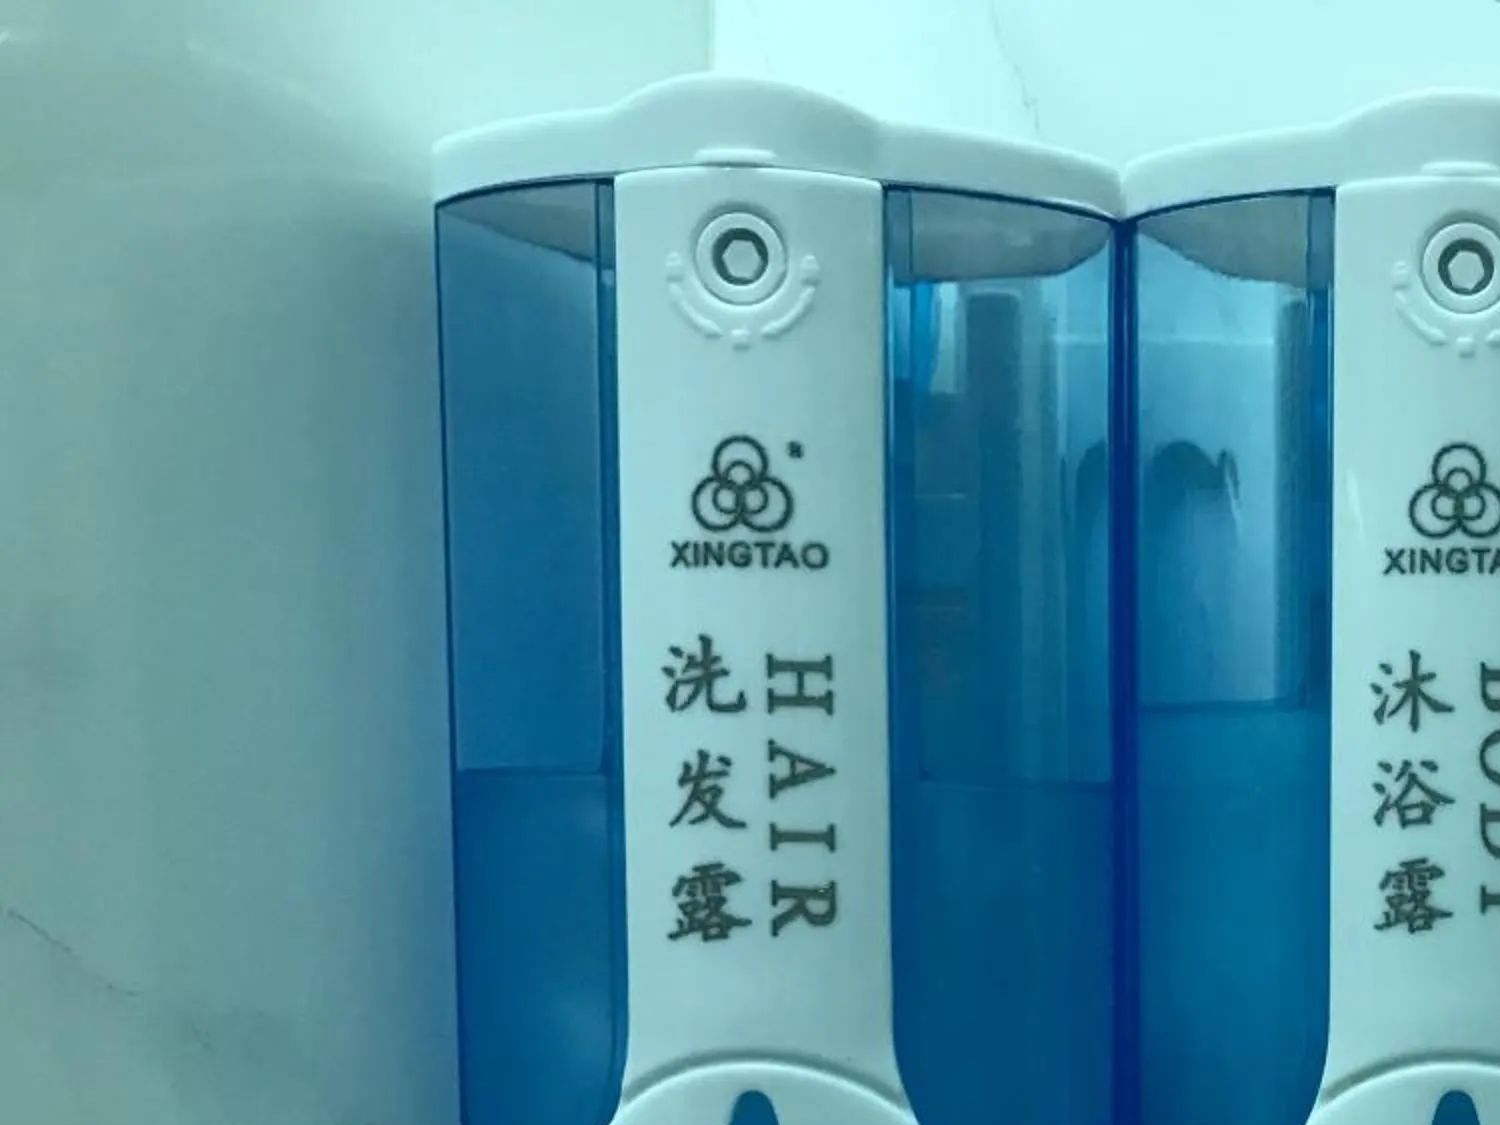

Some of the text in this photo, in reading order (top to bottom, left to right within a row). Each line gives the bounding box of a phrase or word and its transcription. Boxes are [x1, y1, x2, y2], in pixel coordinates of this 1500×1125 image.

[669, 541, 830, 570] XINGTAO
[661, 633, 753, 943] 洗发露
[765, 653, 838, 937] HAIR
[1370, 649, 1456, 936] 沐浴露
